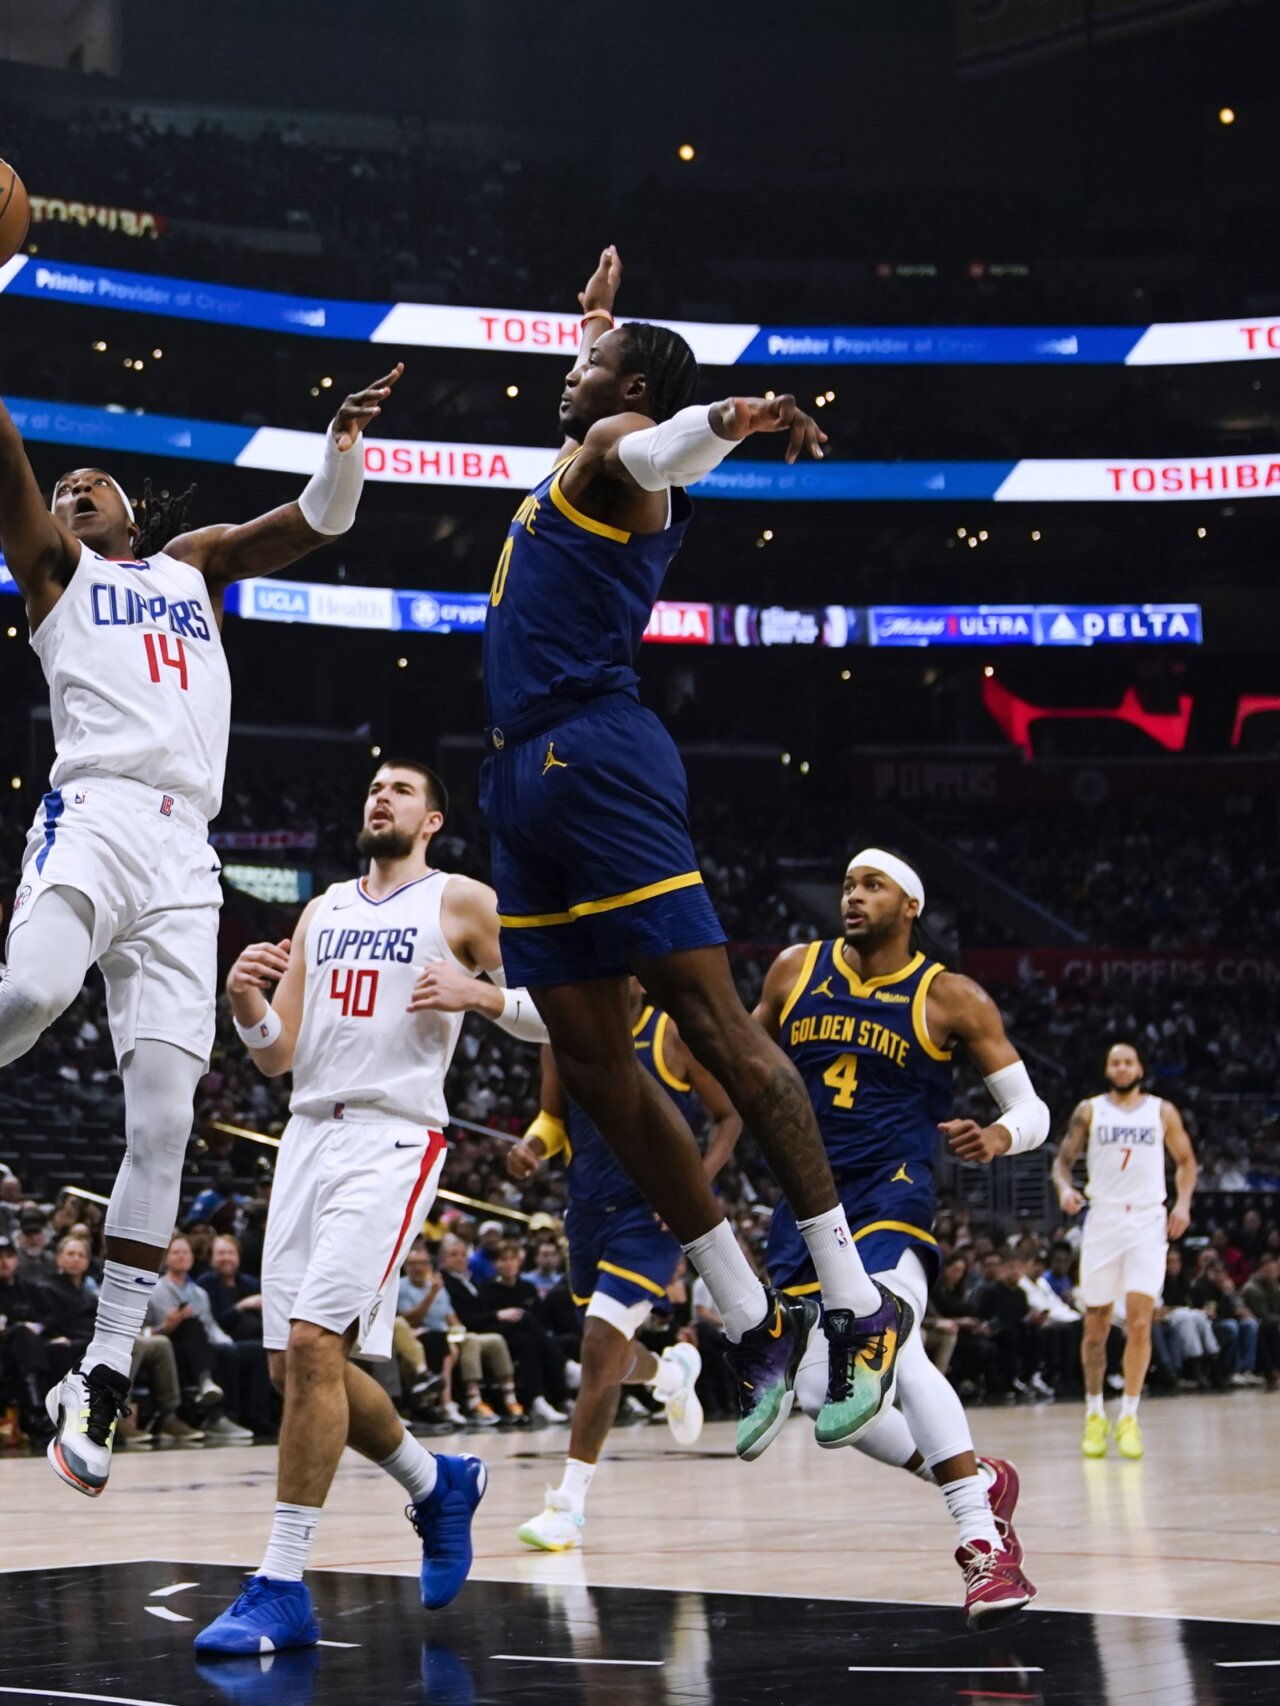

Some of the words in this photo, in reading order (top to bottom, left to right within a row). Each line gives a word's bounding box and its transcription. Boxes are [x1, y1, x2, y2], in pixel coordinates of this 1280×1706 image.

[35, 268, 95, 295] Printer
[363, 447, 510, 479] OSHIBA
[1106, 462, 1280, 492] TOSHIBA
[90, 582, 211, 642] CLIPPERS
[258, 591, 306, 613] UCLA
[959, 614, 1029, 636] ULTRA
[1083, 612, 1190, 637] DELTA
[143, 633, 189, 692] 14
[316, 927, 418, 966] CLIPPERS
[329, 968, 380, 1018] 40
[790, 1014, 856, 1046] GOLDEN
[857, 1019, 910, 1068] STATE
[822, 1052, 858, 1110] 4
[1120, 1146, 1133, 1172] 7
